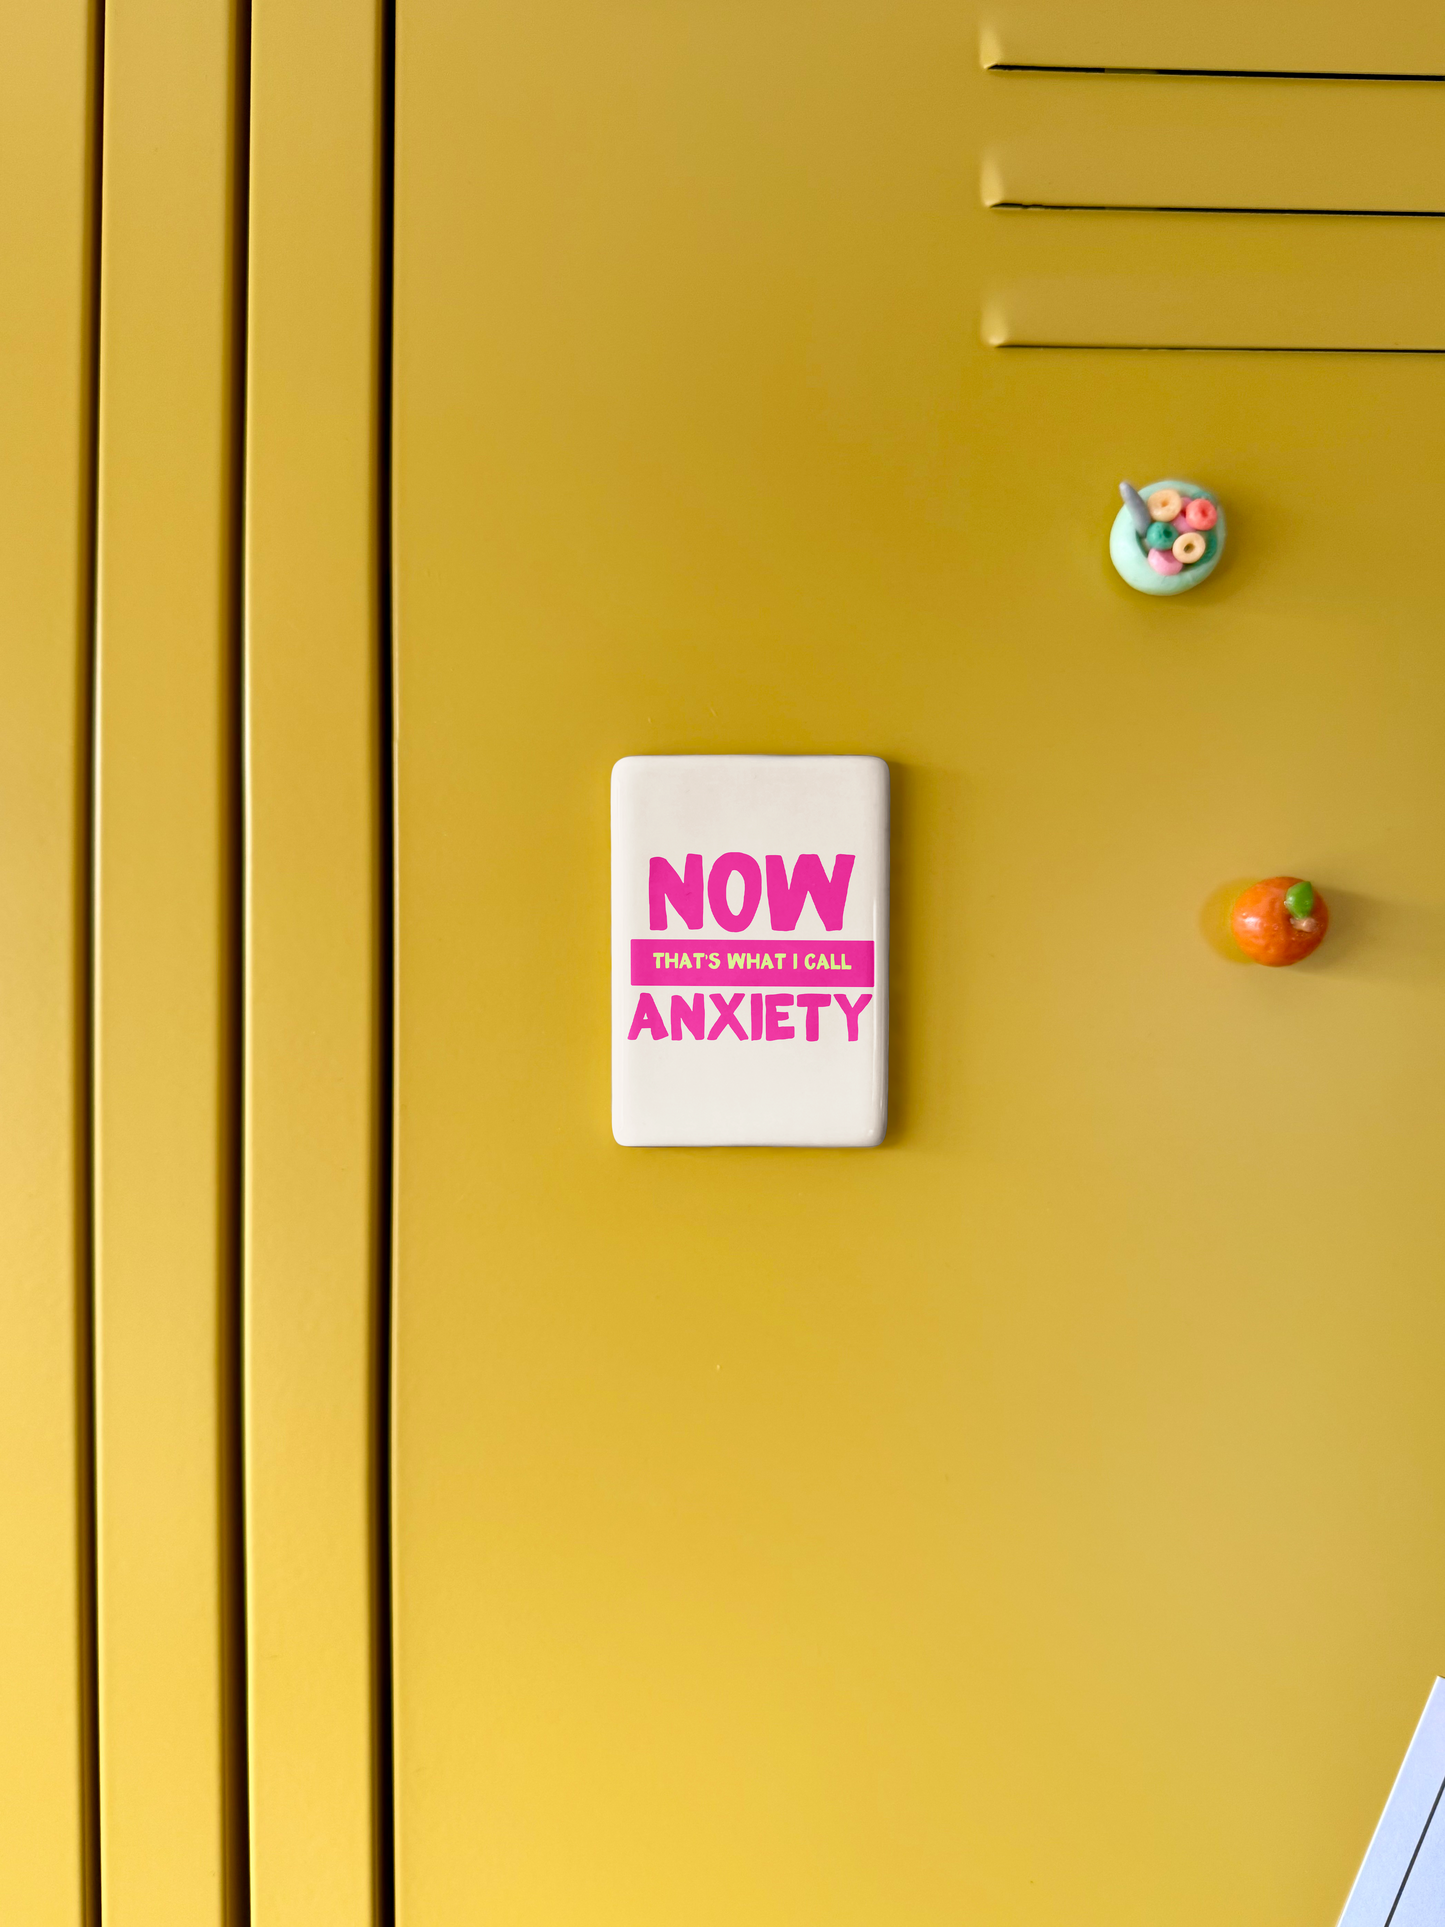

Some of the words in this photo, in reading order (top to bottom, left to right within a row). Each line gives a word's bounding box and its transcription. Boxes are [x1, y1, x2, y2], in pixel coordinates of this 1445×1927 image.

[648, 852, 856, 932] NOW
[652, 952, 721, 969] THAT'S
[727, 952, 787, 970] WHAT
[792, 952, 798, 970] I
[804, 953, 852, 970] CALL
[627, 993, 873, 1041] ANXIETY
